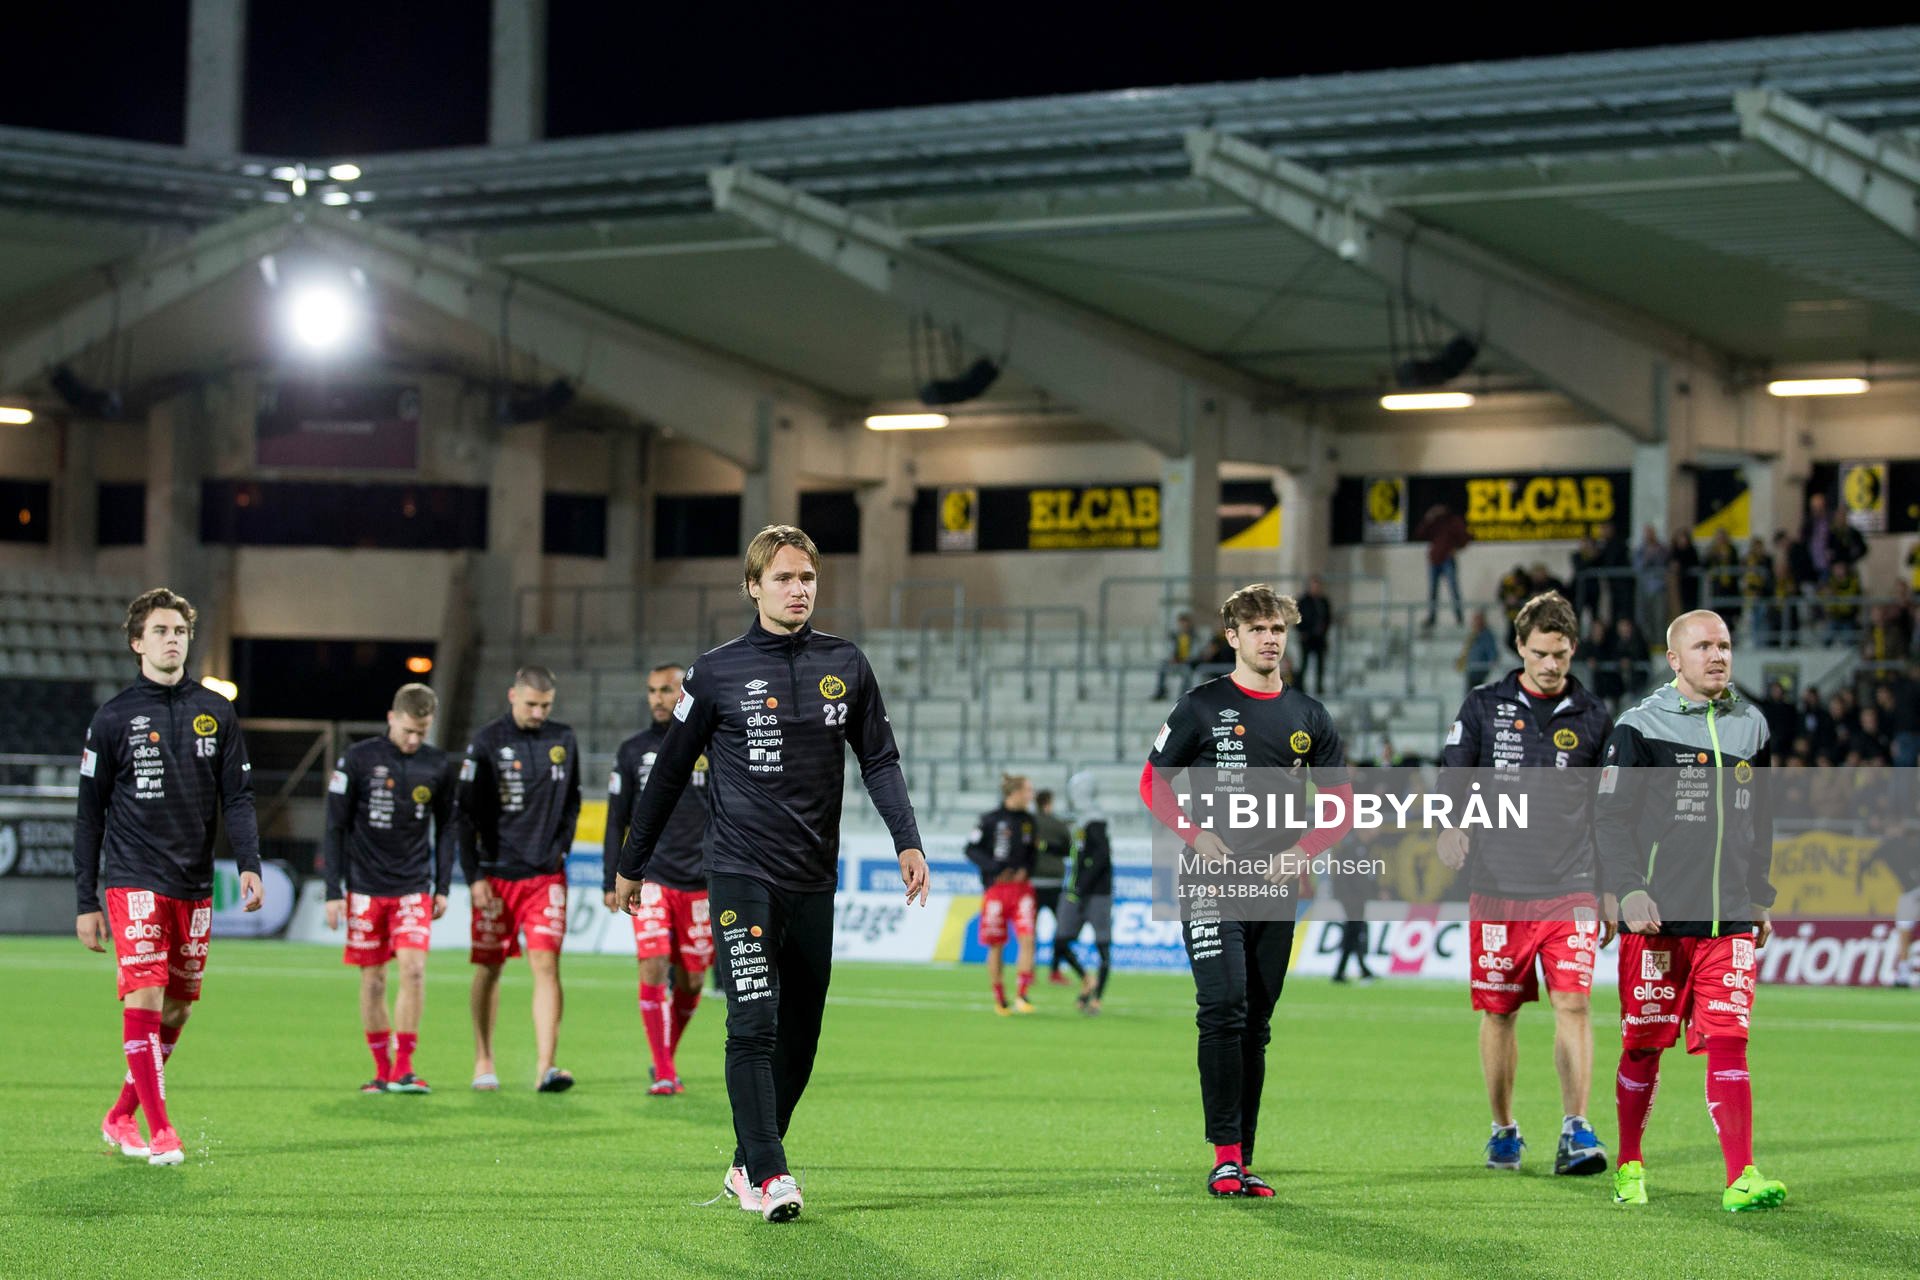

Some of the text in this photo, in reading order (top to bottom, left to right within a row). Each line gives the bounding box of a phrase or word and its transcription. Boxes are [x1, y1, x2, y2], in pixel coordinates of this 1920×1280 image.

[1466, 476, 1614, 522] ELCAB
[1029, 486, 1160, 530] ELCAB
[747, 712, 778, 727] ellos
[822, 702, 848, 727] 22
[746, 728, 781, 739] Folksam
[1496, 729, 1522, 742] ellos
[195, 737, 217, 757] 15
[747, 738, 783, 747] PULSEN
[1216, 738, 1244, 752] ellos
[133, 745, 160, 758] ellos
[1216, 753, 1247, 761] Folksam
[1289, 758, 1302, 775] 2
[1555, 751, 1569, 771] 5
[1679, 765, 1706, 779] ellos
[1735, 788, 1750, 809] 10
[1191, 897, 1218, 910] ellos
[125, 920, 161, 939] ellos
[1317, 919, 1462, 960] DLOC
[730, 940, 762, 956] ellos
[730, 956, 767, 968] Folksam
[1479, 951, 1514, 970] ellos
[732, 965, 768, 978] PULSEN
[1723, 970, 1754, 993] ellos
[1633, 982, 1676, 1000] ellos
